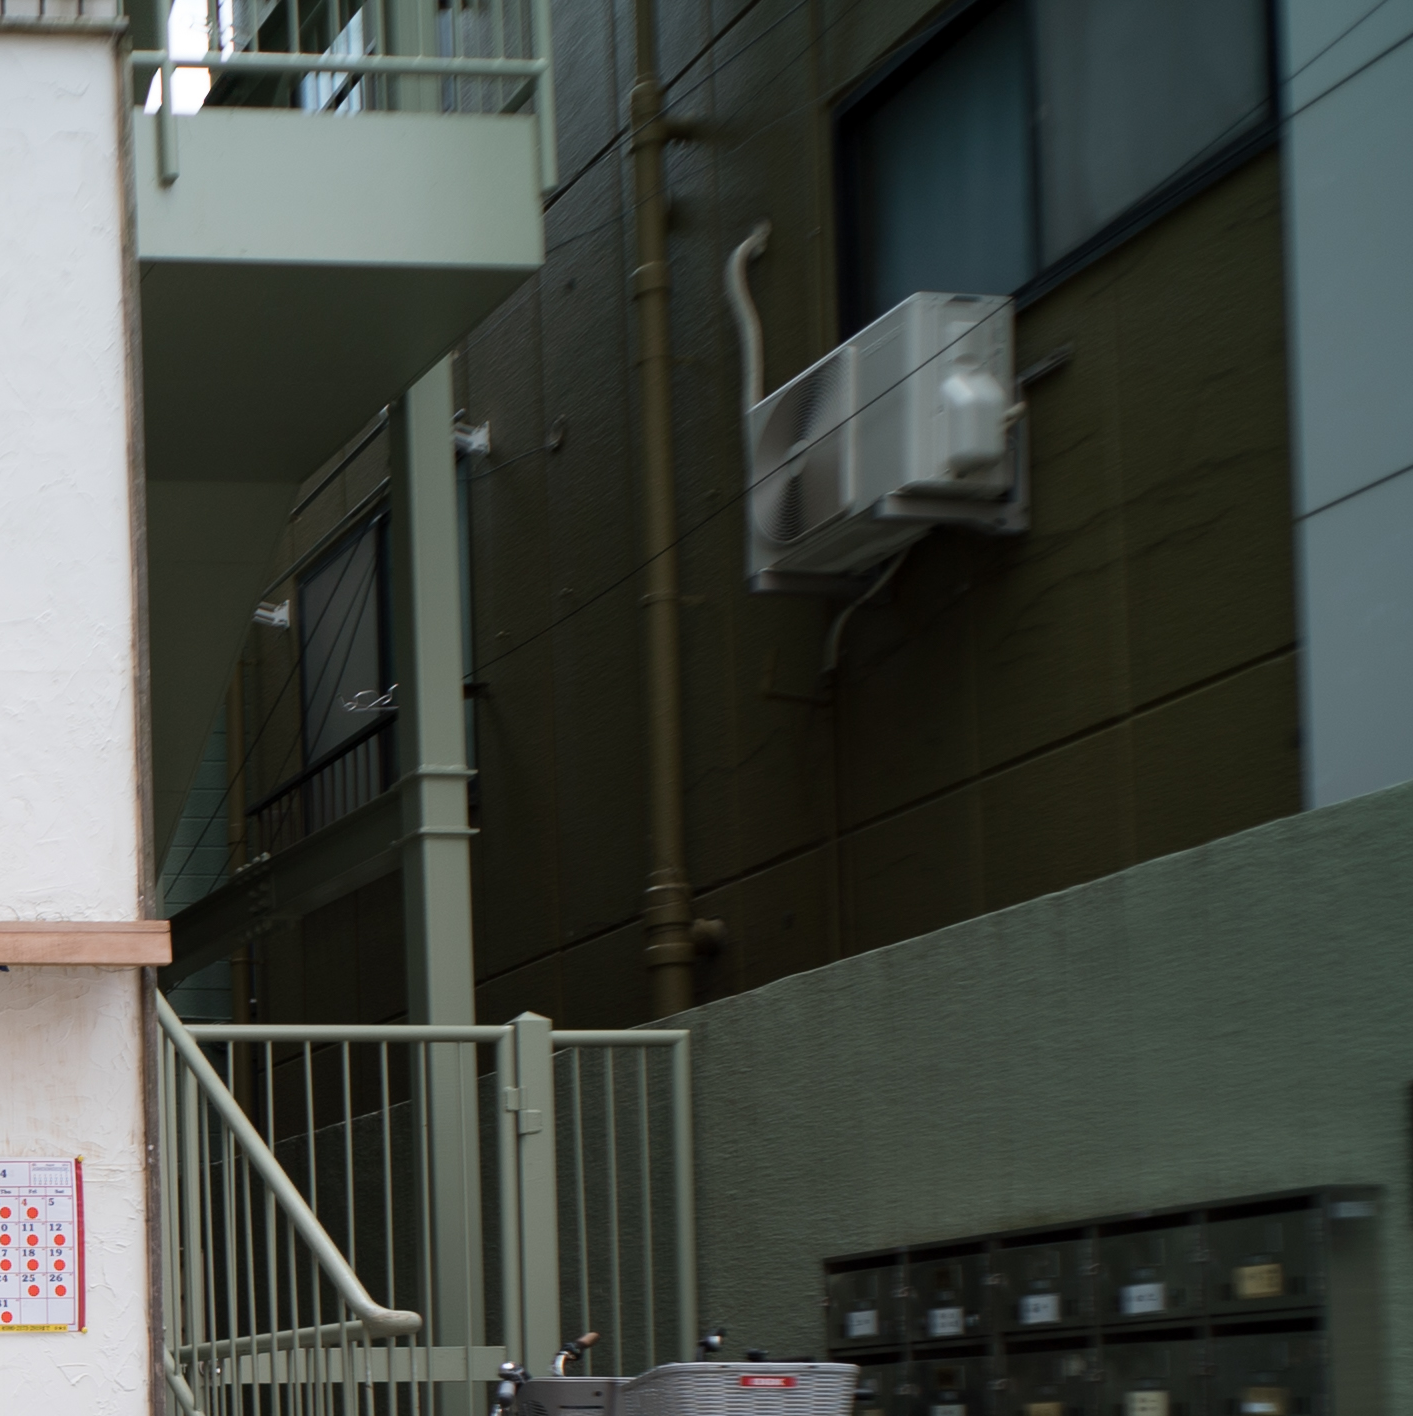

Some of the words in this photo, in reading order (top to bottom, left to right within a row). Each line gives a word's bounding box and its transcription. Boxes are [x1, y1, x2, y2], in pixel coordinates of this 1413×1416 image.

[49, 1198, 54, 1206] 5
[22, 1274, 35, 1282] 25
[50, 1274, 62, 1282] 26
